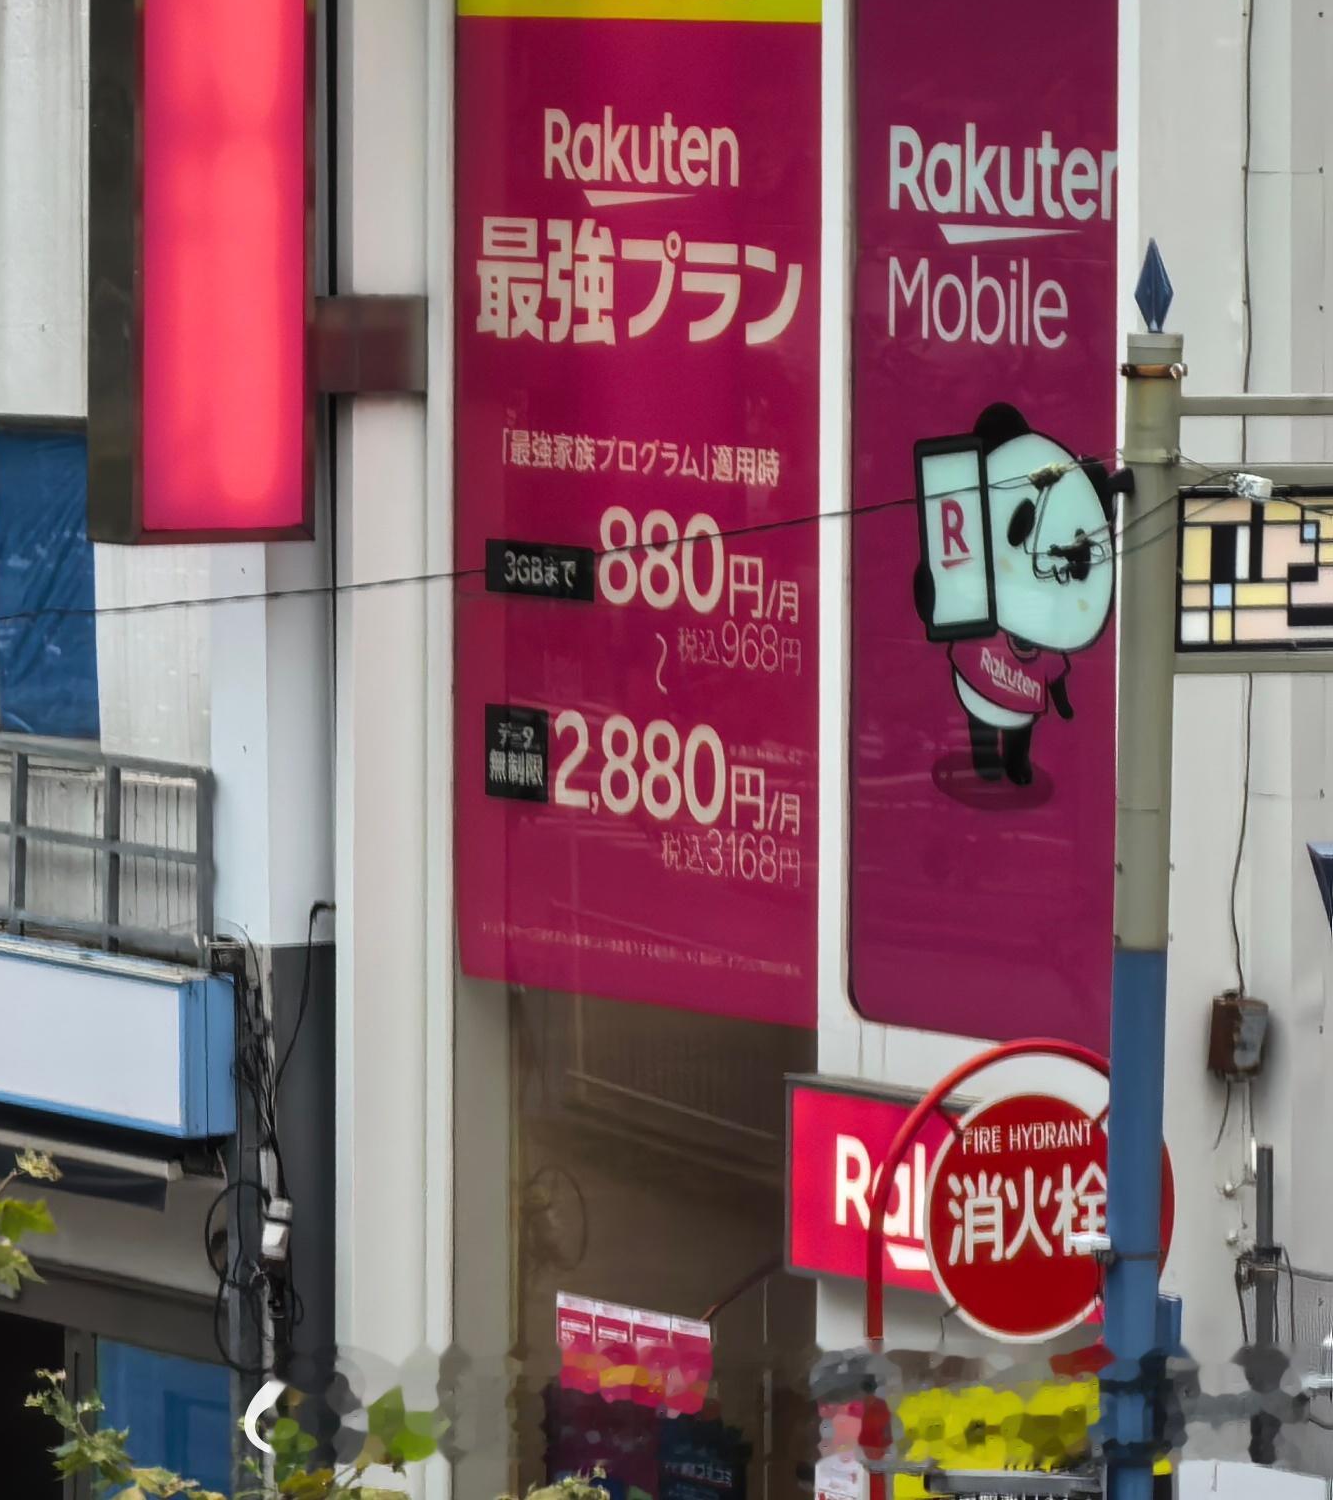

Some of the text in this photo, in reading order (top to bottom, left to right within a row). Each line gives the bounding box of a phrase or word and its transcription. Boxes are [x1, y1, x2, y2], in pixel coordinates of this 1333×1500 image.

[544, 105, 740, 188] Rakuten
[476, 216, 803, 346] 最強プラン
[889, 255, 1069, 350] Mobile
[502, 427, 780, 488] 「最強家族プログラム」適用時
[940, 499, 970, 556] R
[504, 550, 577, 589] 3GBまで
[980, 647, 1040, 703] Rakuten
[489, 749, 544, 788] 無制限
[962, 1118, 1093, 1155] FIRE HYDRANT
[947, 1161, 1108, 1267] 消火栓
